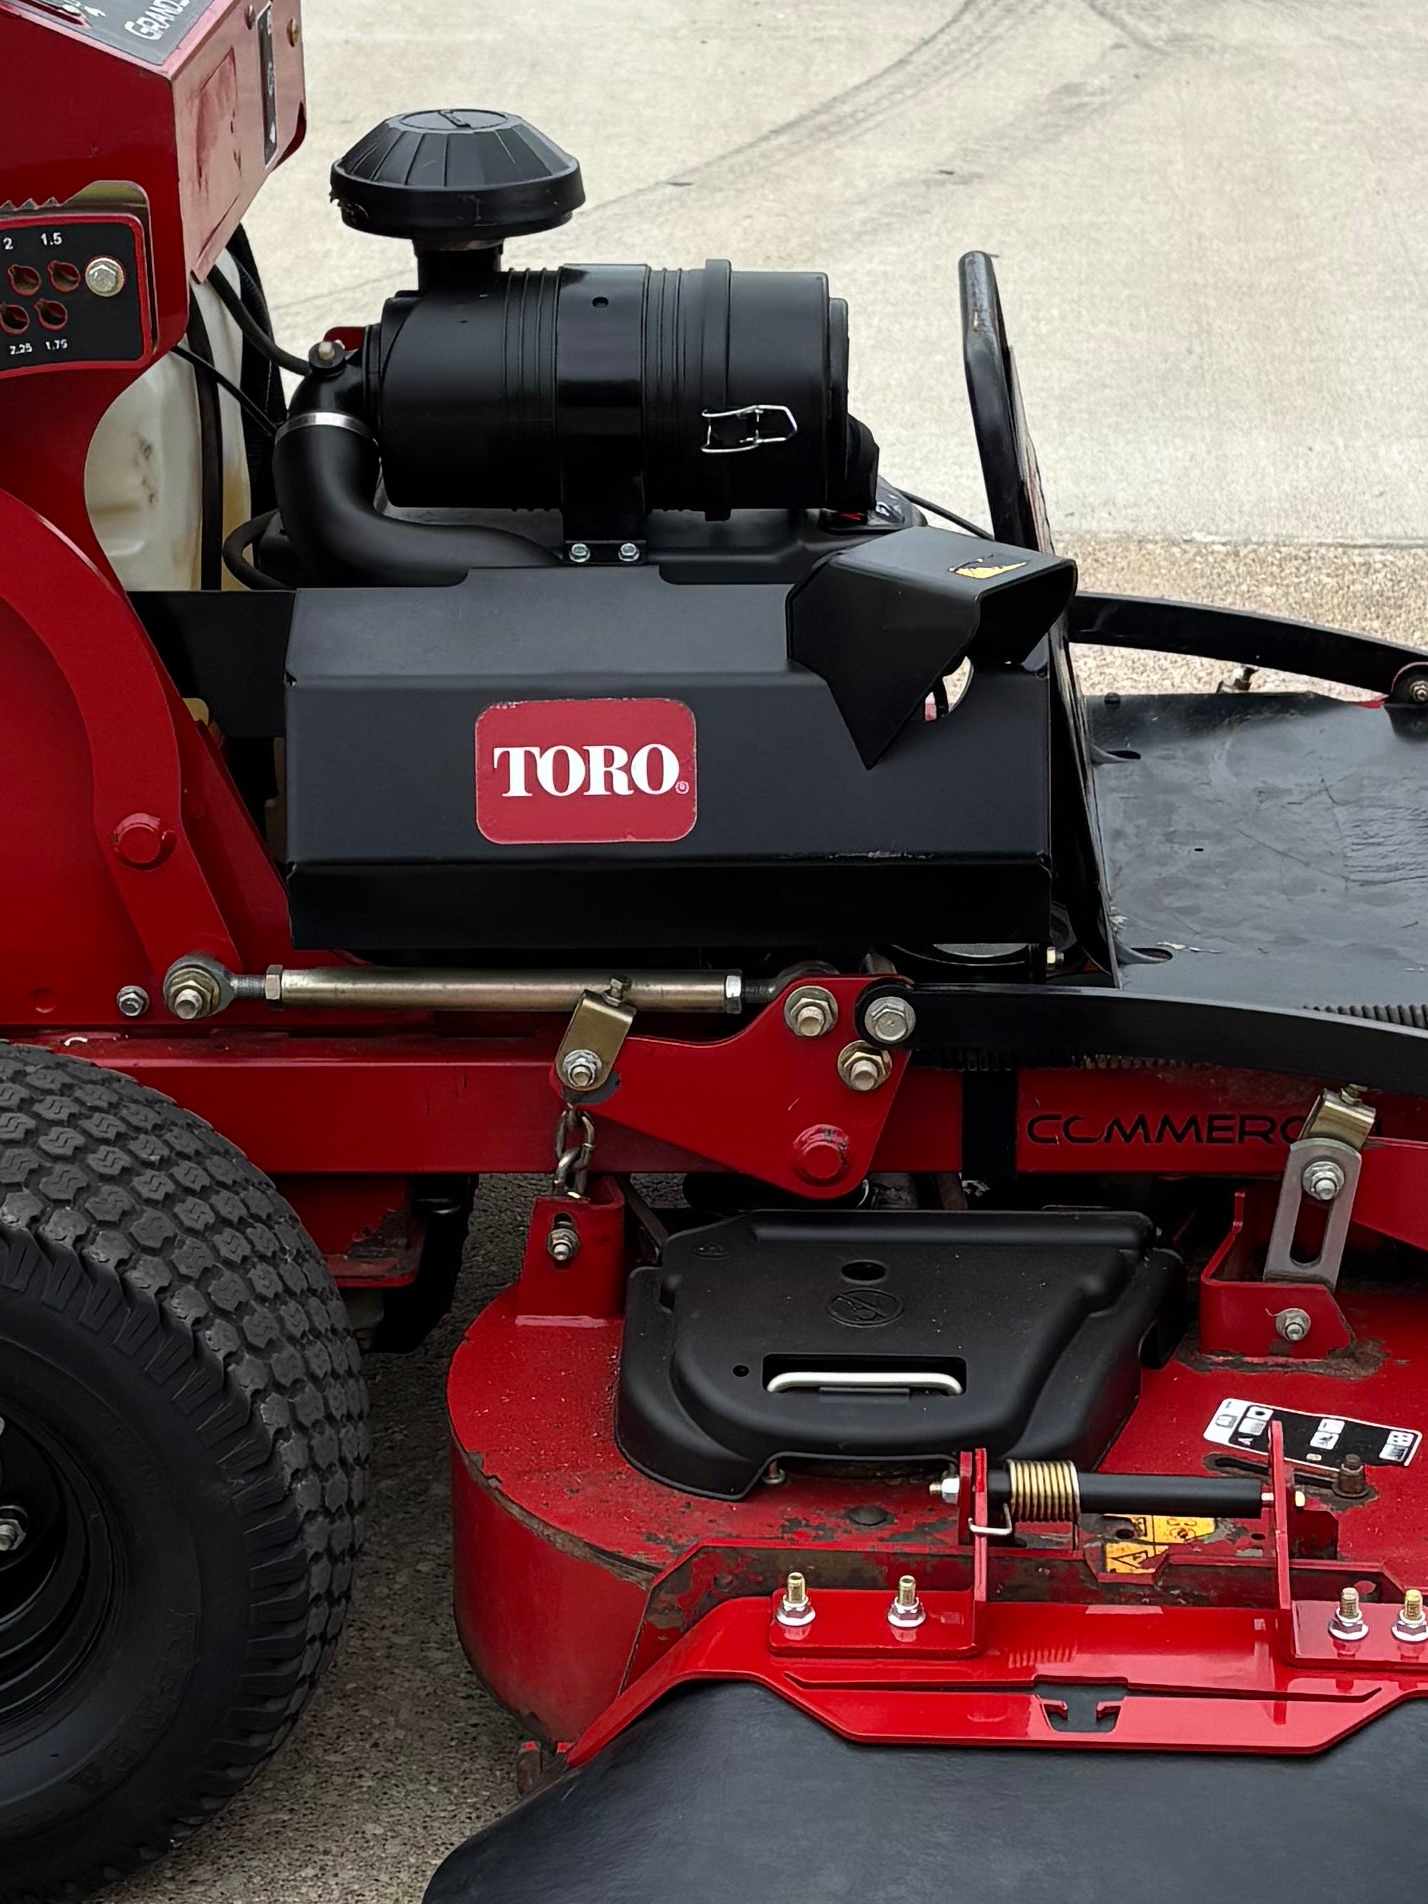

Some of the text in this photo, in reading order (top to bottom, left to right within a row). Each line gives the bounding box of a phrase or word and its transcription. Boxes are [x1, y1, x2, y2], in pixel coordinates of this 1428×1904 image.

[3, 237, 14, 250] 2
[41, 232, 63, 246] 1.5
[9, 342, 33, 355] 2.25
[45, 338, 68, 351] 1.75
[493, 743, 680, 797] TORO
